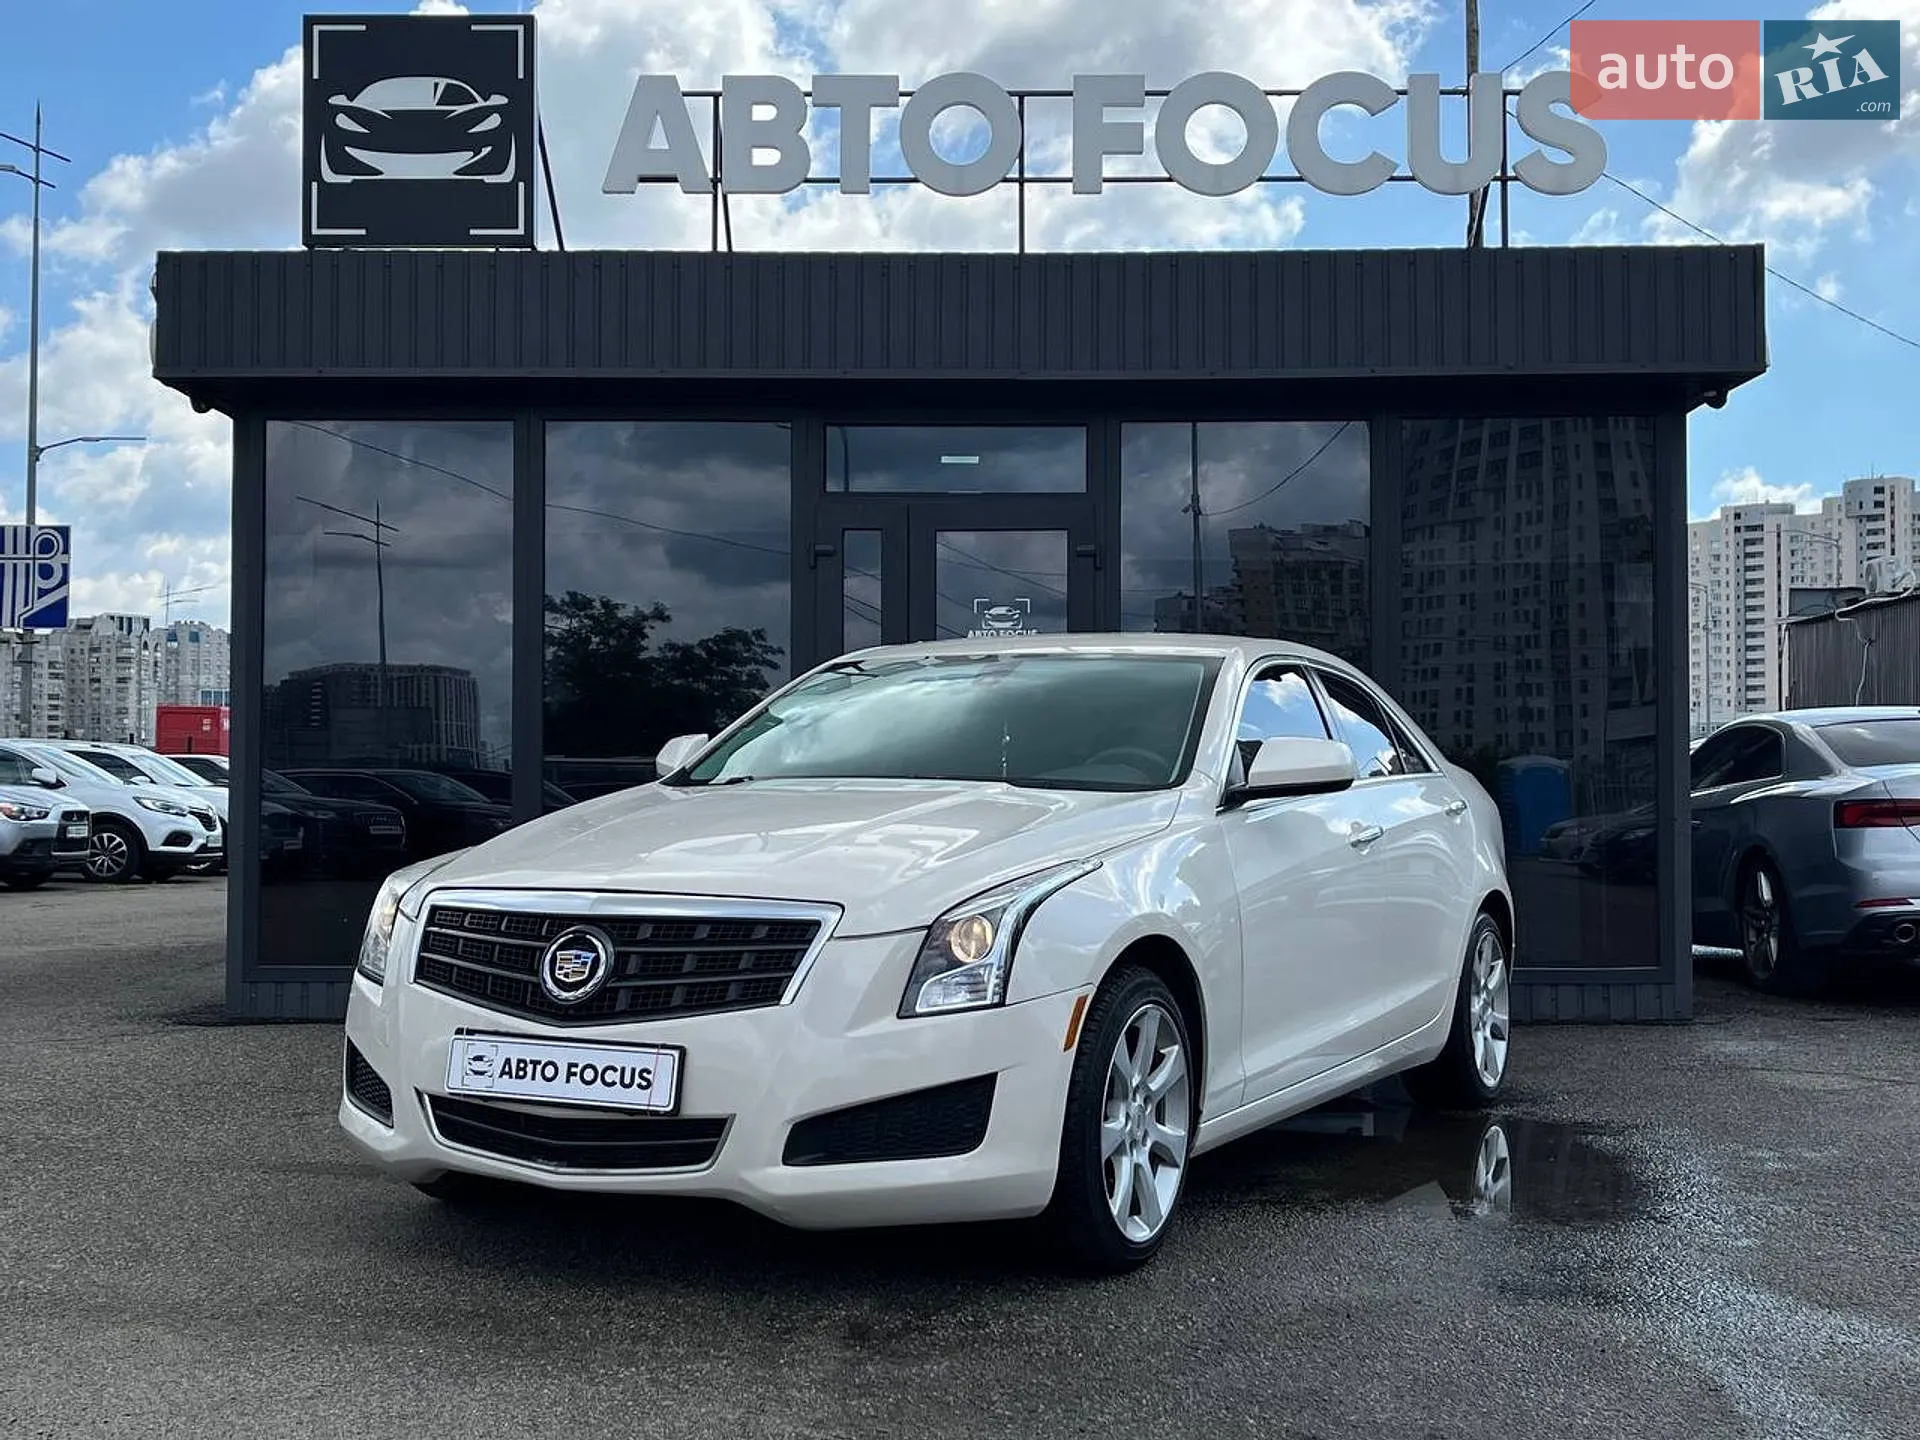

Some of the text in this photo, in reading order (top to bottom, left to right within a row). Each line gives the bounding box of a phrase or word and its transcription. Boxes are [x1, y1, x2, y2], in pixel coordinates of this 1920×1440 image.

[602, 71, 1608, 196] АВТО FOCUS
[498, 1057, 654, 1091] АВТО FOCUS
